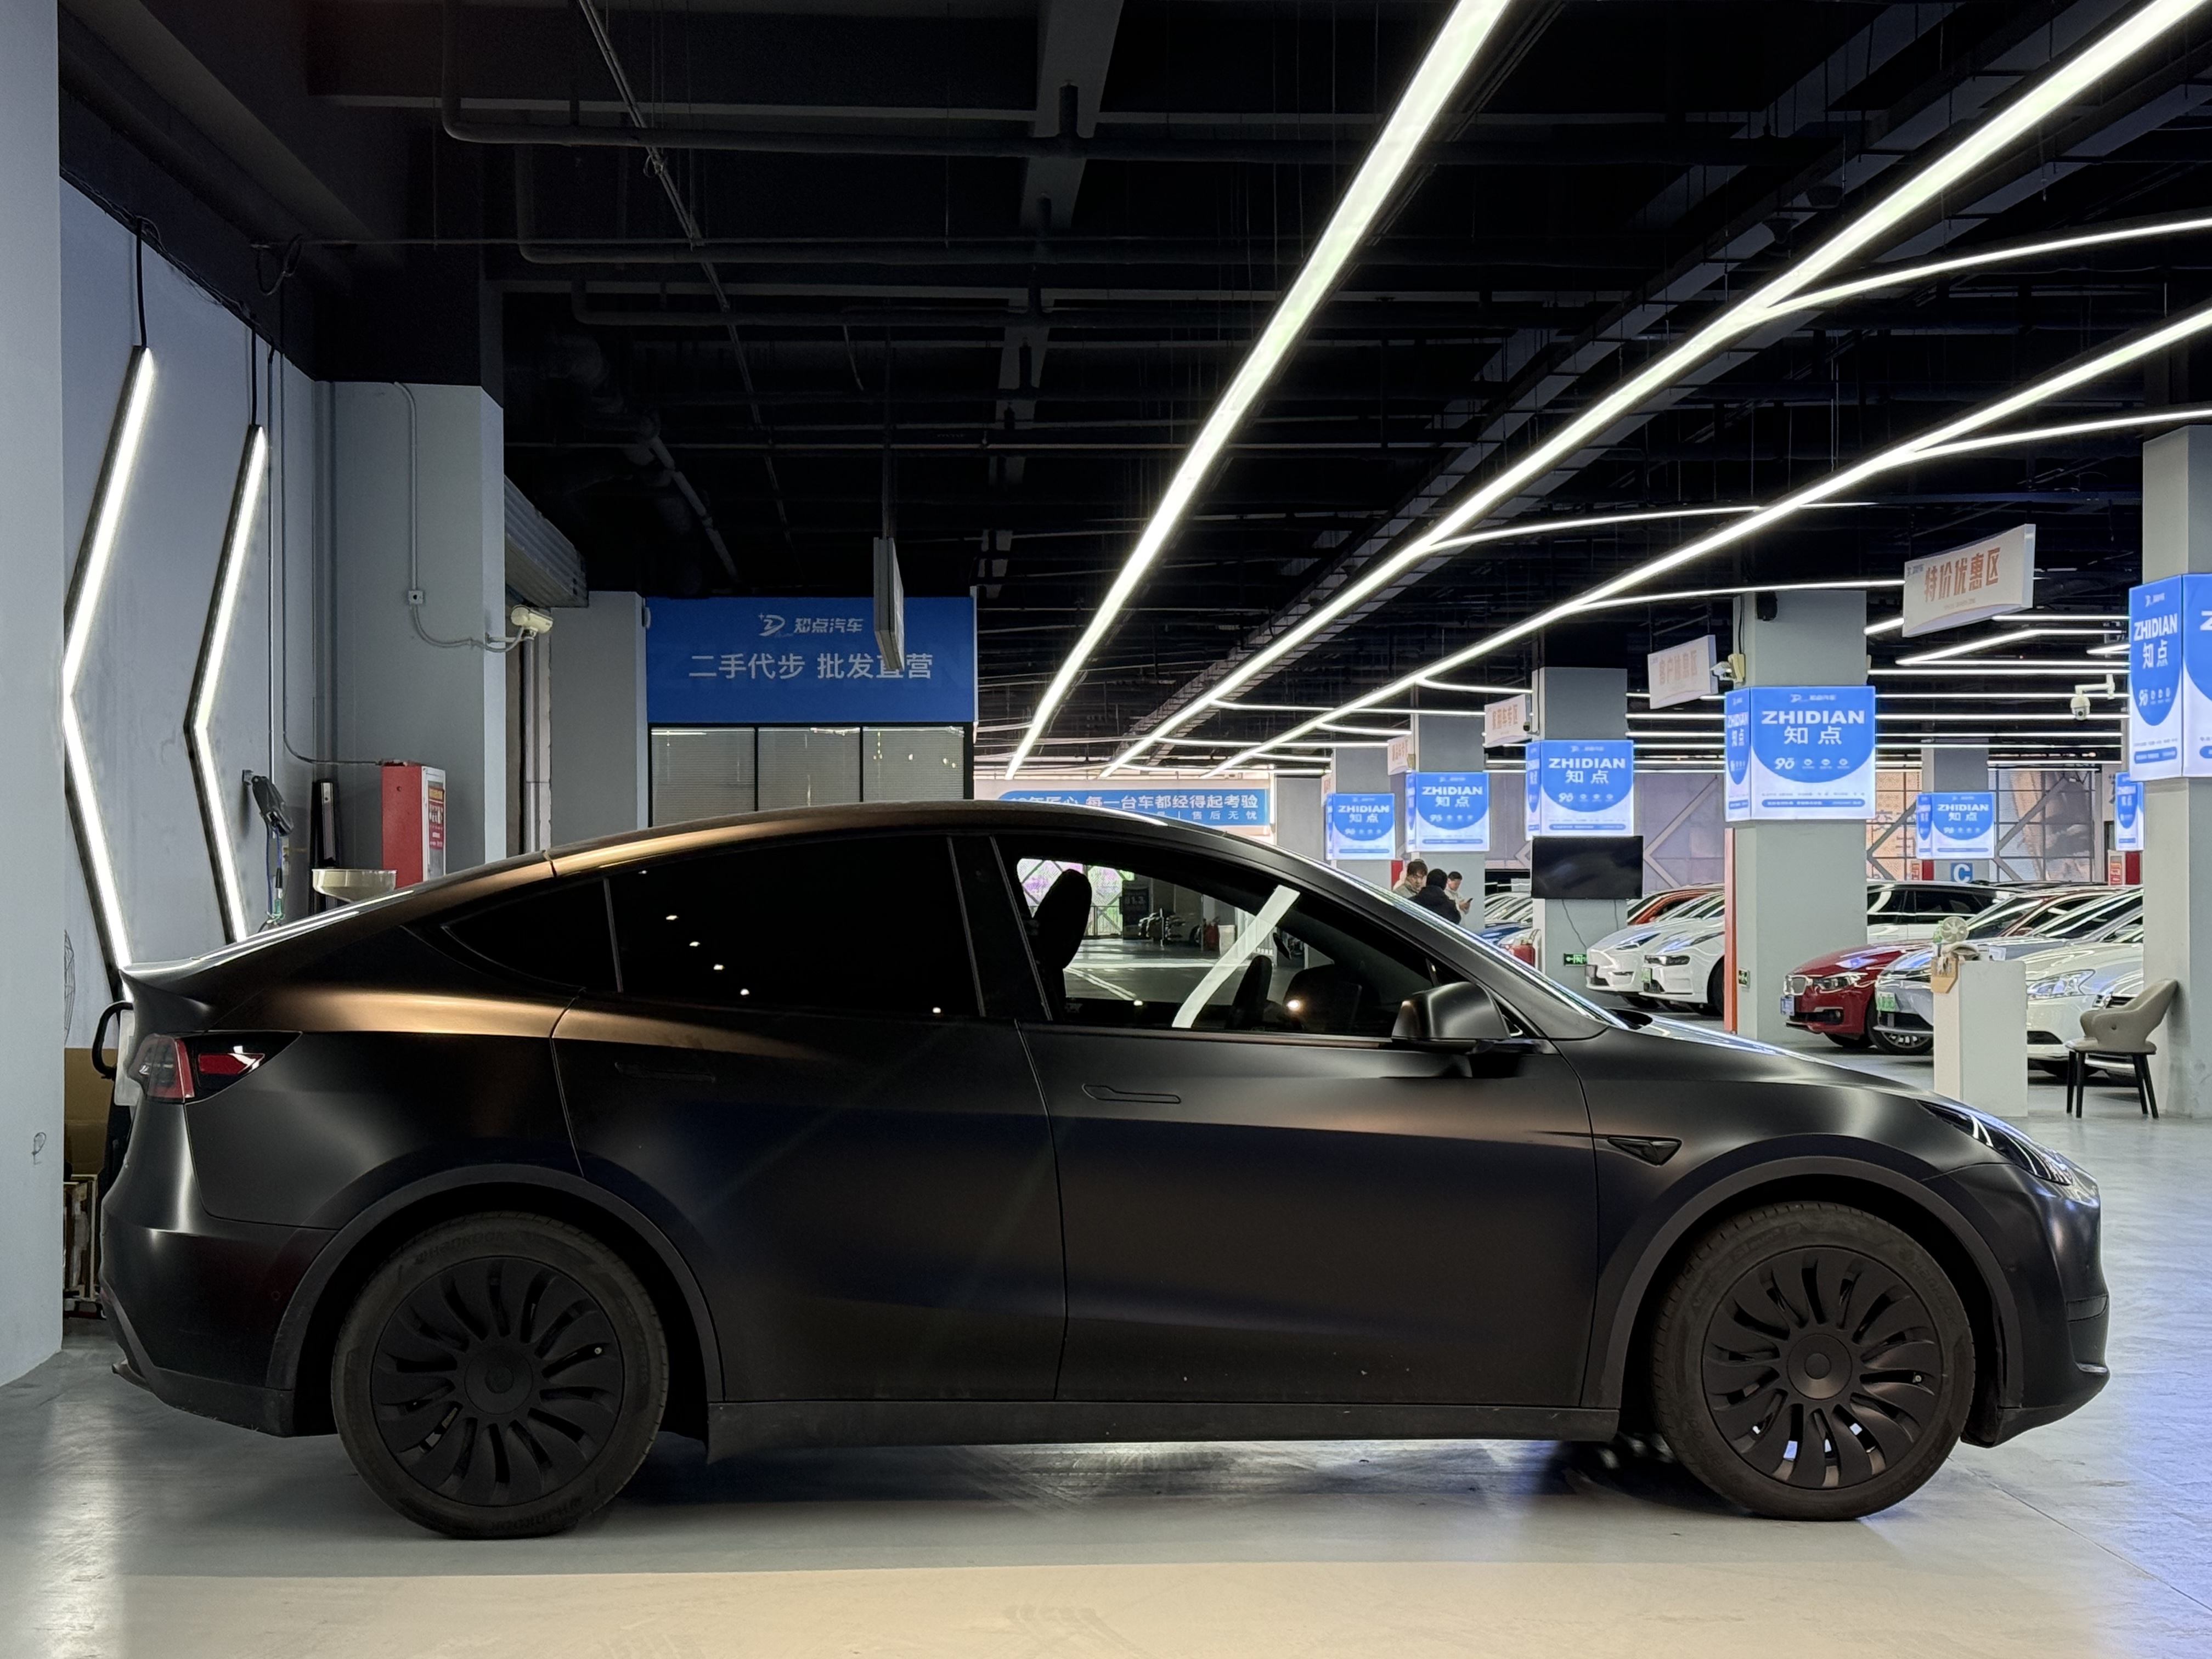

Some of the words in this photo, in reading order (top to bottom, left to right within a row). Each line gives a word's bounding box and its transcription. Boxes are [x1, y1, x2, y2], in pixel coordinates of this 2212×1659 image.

[1925, 548, 2001, 602] 特价优惠区
[794, 618, 864, 633] 知点汽车
[2134, 613, 2178, 641] ZHIDIAN
[2143, 639, 2169, 669] 知点
[689, 653, 805, 679] 二手代步
[1762, 710, 1865, 724] ZHIDIAN
[1784, 726, 1842, 744] 知点
[1549, 758, 1626, 769] ZHIDIAN
[1565, 770, 1609, 784] 知点
[1421, 786, 1483, 795] ZHIDIAN
[1086, 795, 1258, 809] 每一台车都经得起考验
[1338, 805, 1390, 813] ZHIDIAN
[1435, 796, 1470, 808] 知点
[1953, 864, 1971, 883] C
